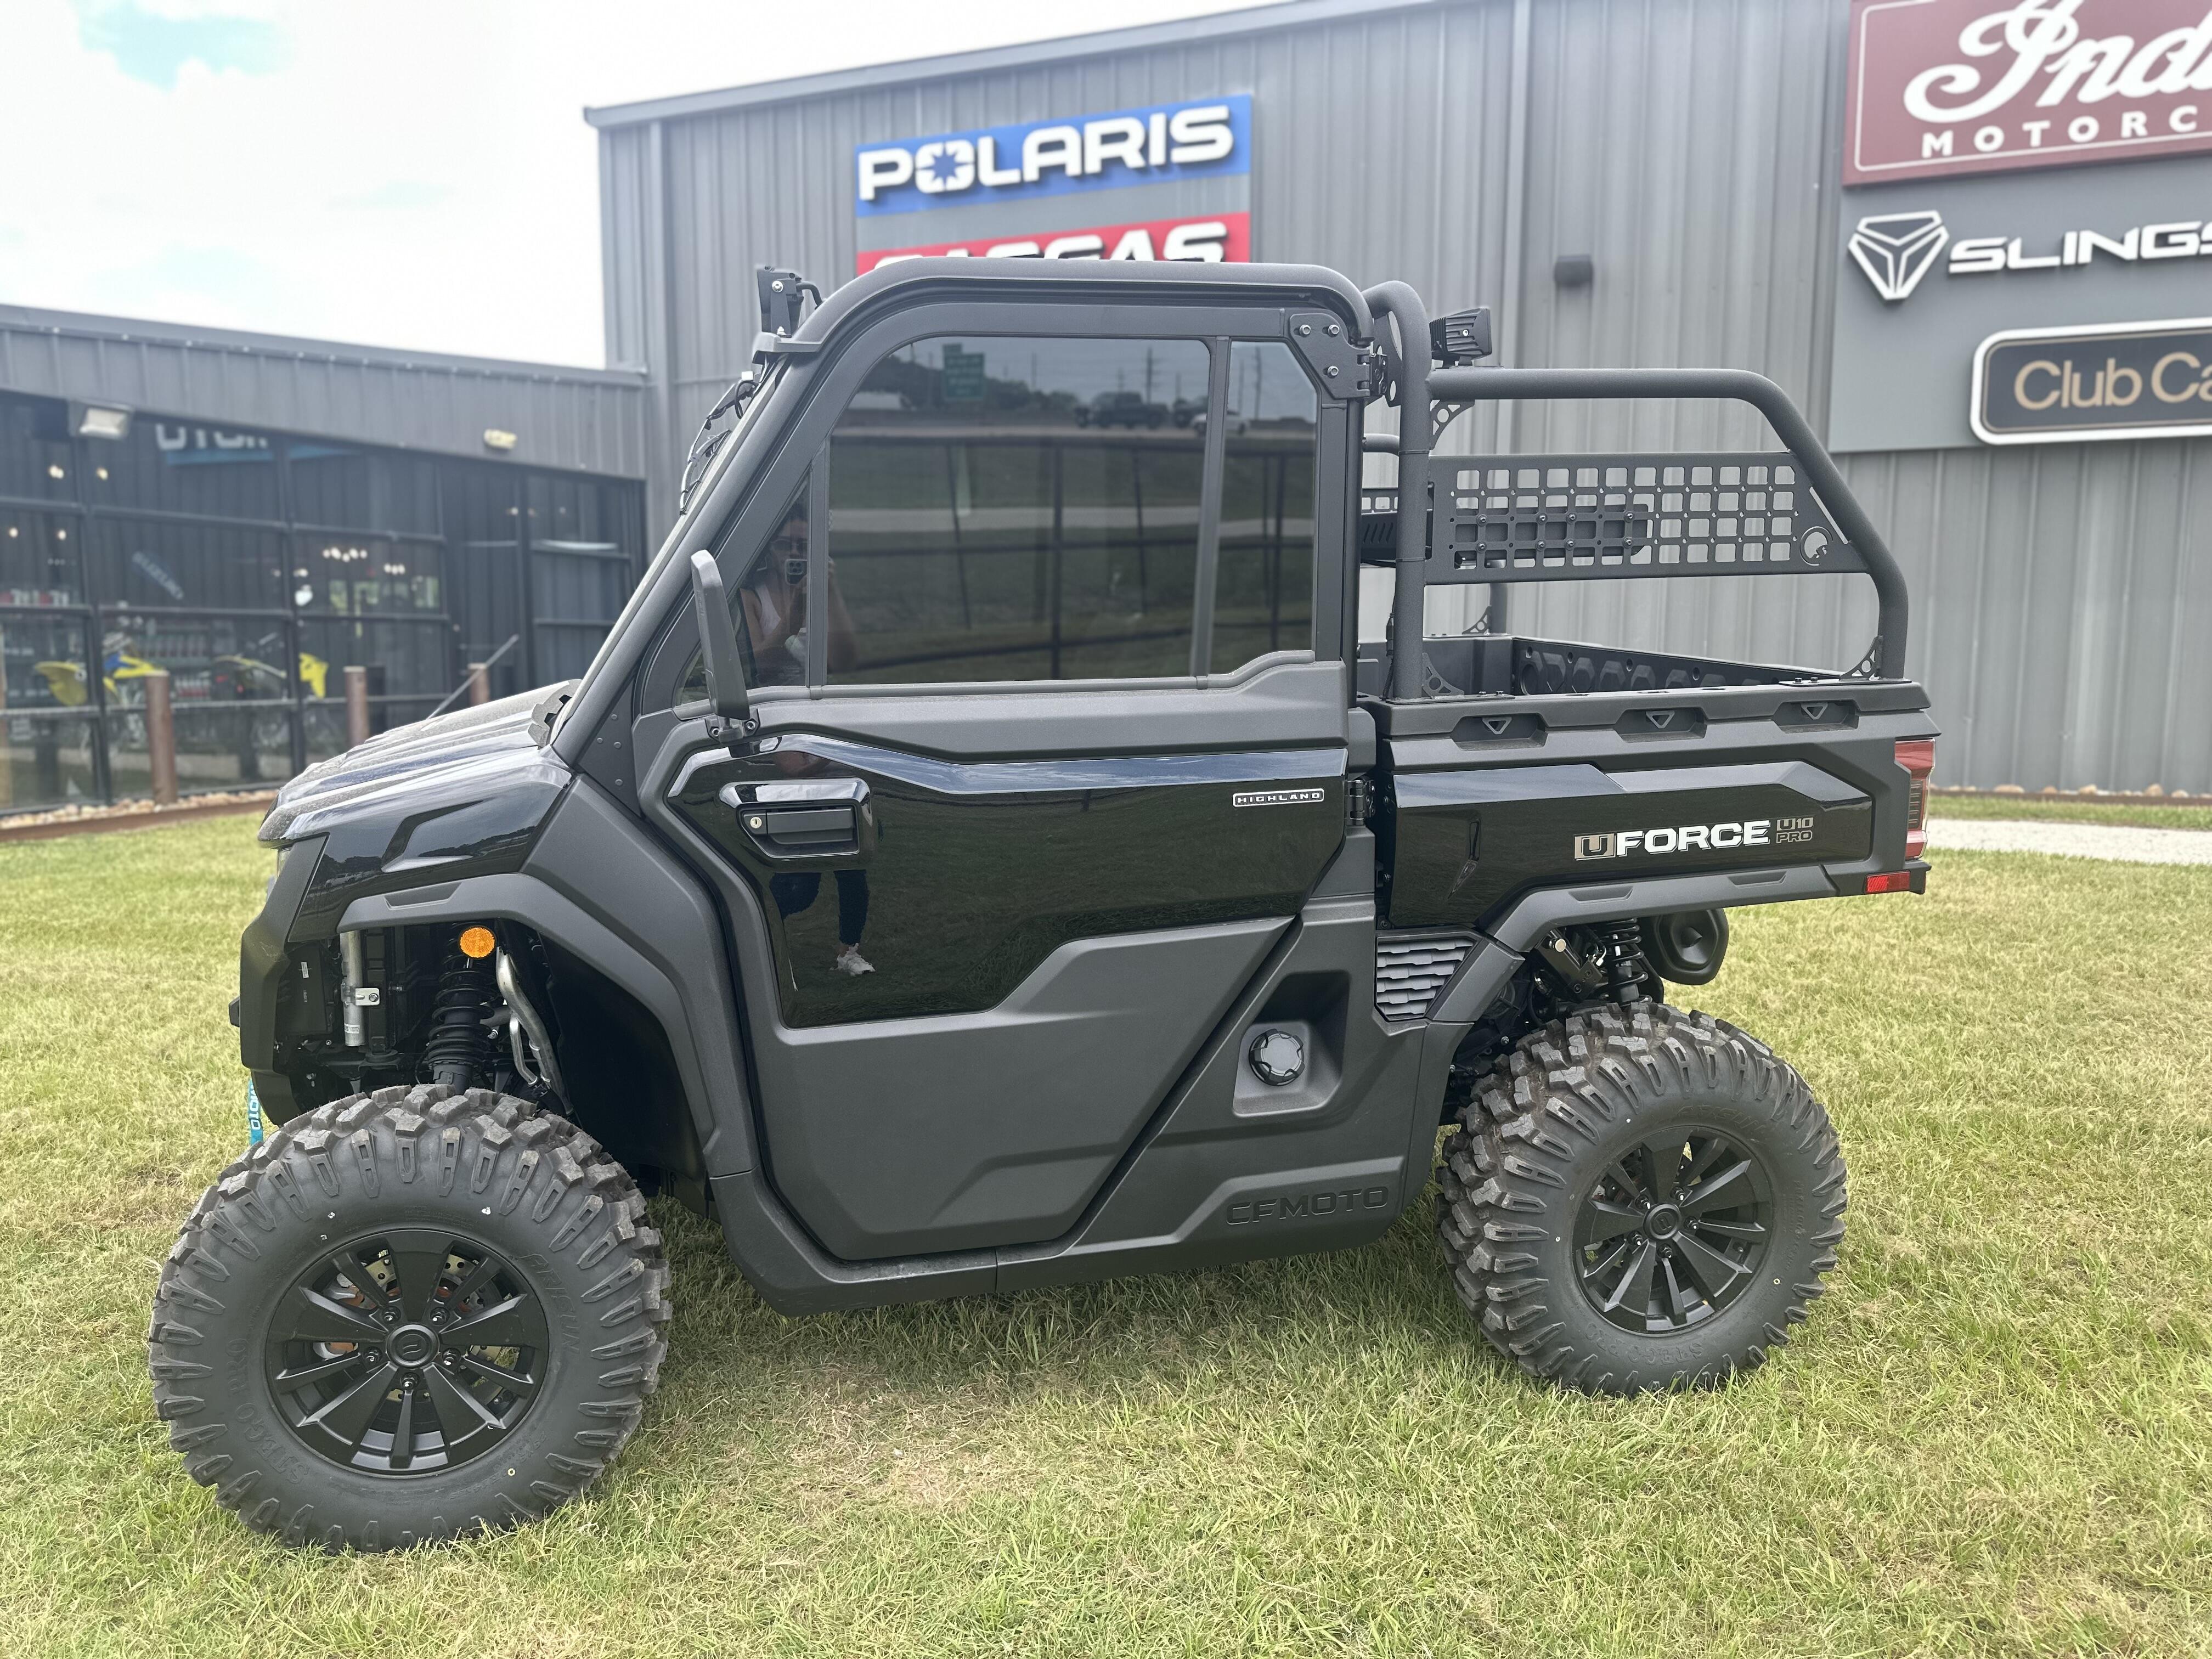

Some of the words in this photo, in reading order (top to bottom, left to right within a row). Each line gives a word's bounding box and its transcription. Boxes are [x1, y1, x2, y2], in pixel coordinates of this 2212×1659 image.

[859, 105, 1234, 201] POLARIS
[2014, 358, 2143, 410] Club
[1237, 792, 1321, 804] HIGHLAND
[1574, 820, 1771, 861] UFORCE
[1776, 817, 1814, 832] U10
[1776, 830, 1813, 844] PRO
[1226, 1186, 1389, 1225] CFMOTO
[519, 1254, 580, 1353] ARISUN
[225, 1338, 249, 1395] PRO
[235, 1402, 310, 1484] STEGO
